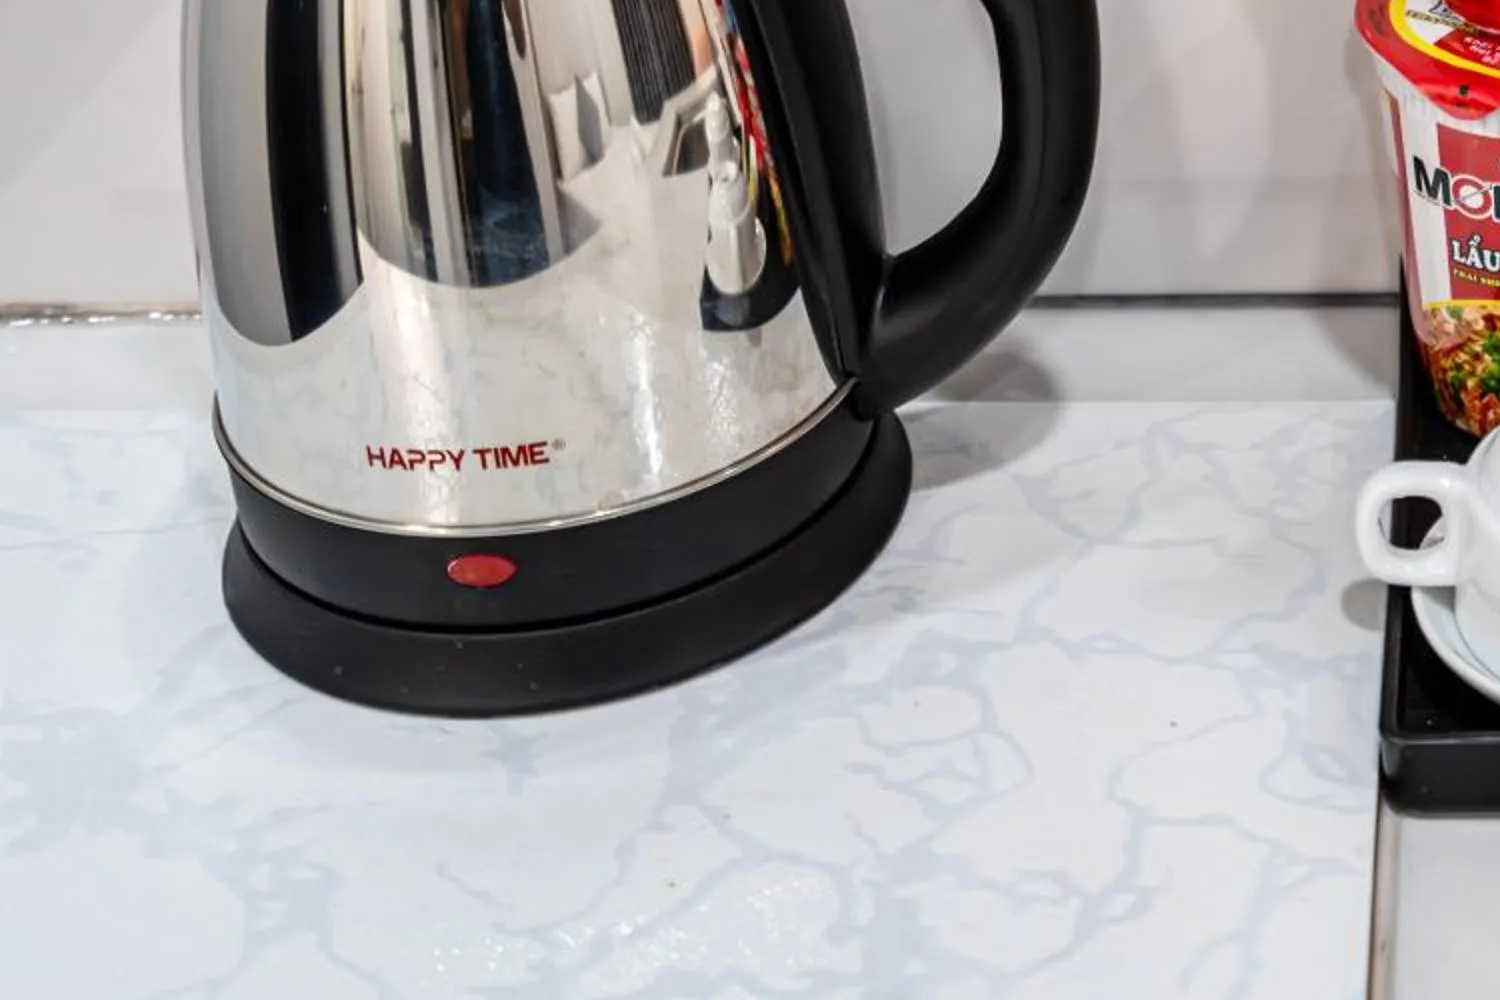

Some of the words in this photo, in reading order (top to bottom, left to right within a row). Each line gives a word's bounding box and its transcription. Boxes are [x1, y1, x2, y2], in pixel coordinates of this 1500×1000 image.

[1452, 235, 1500, 273] LẨU
[366, 445, 465, 471] HAPPY
[473, 441, 550, 470] TIME
